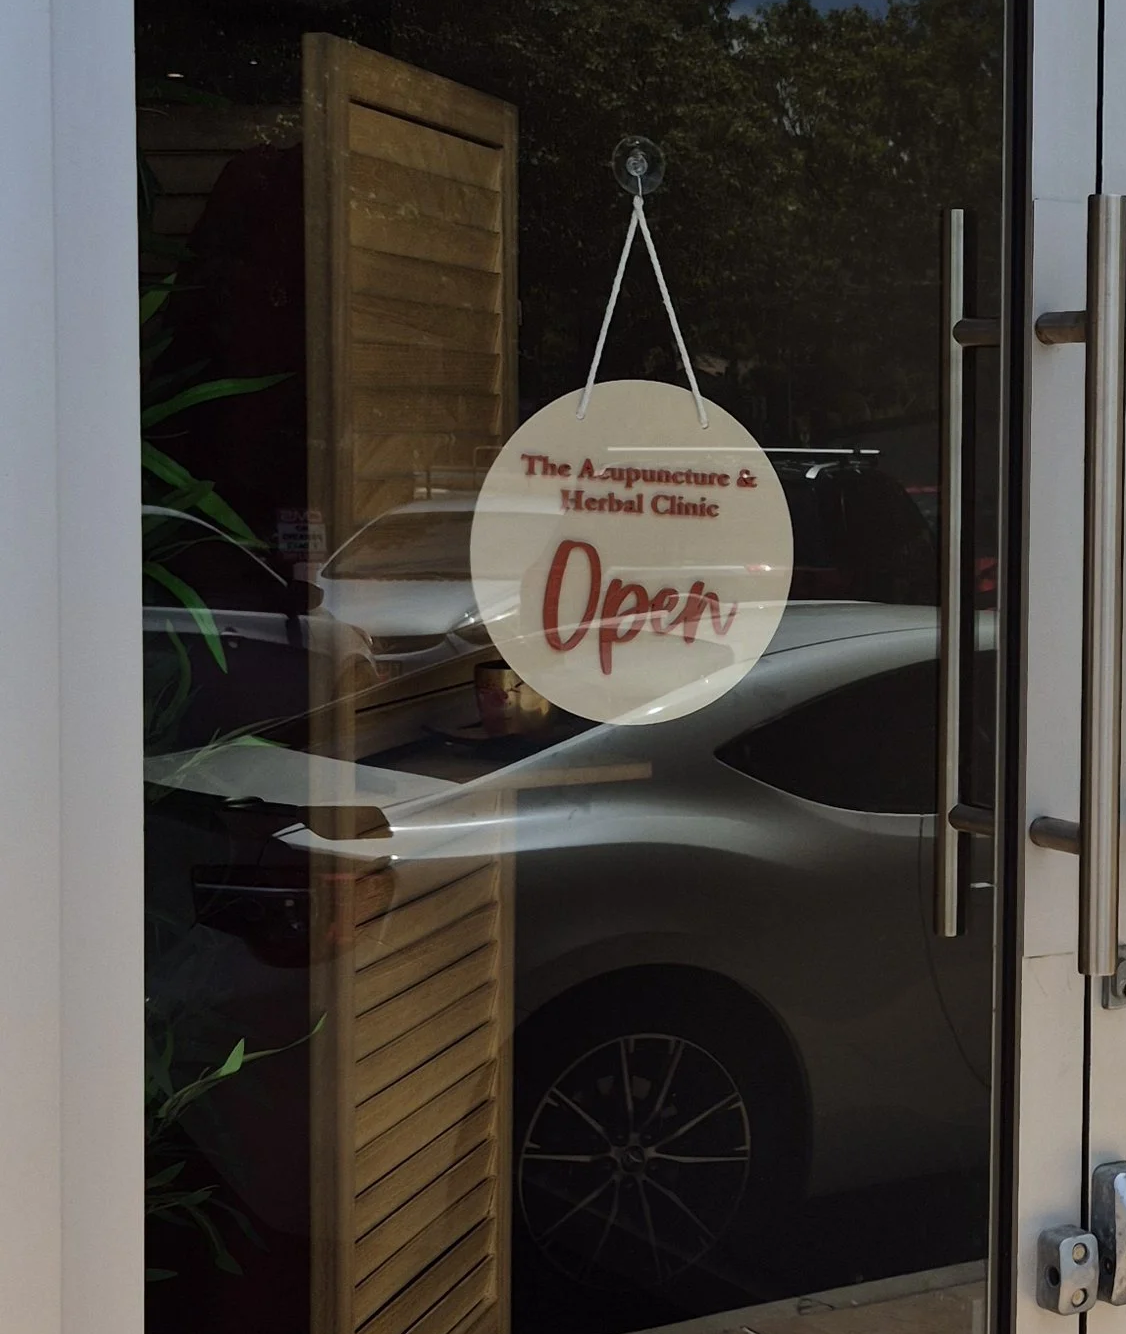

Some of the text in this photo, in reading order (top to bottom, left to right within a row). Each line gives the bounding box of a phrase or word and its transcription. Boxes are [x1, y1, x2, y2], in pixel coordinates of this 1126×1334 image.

[521, 453, 571, 478] The
[736, 469, 757, 489] &
[560, 489, 719, 519] Herbal Clinic
[543, 539, 739, 677] Open
